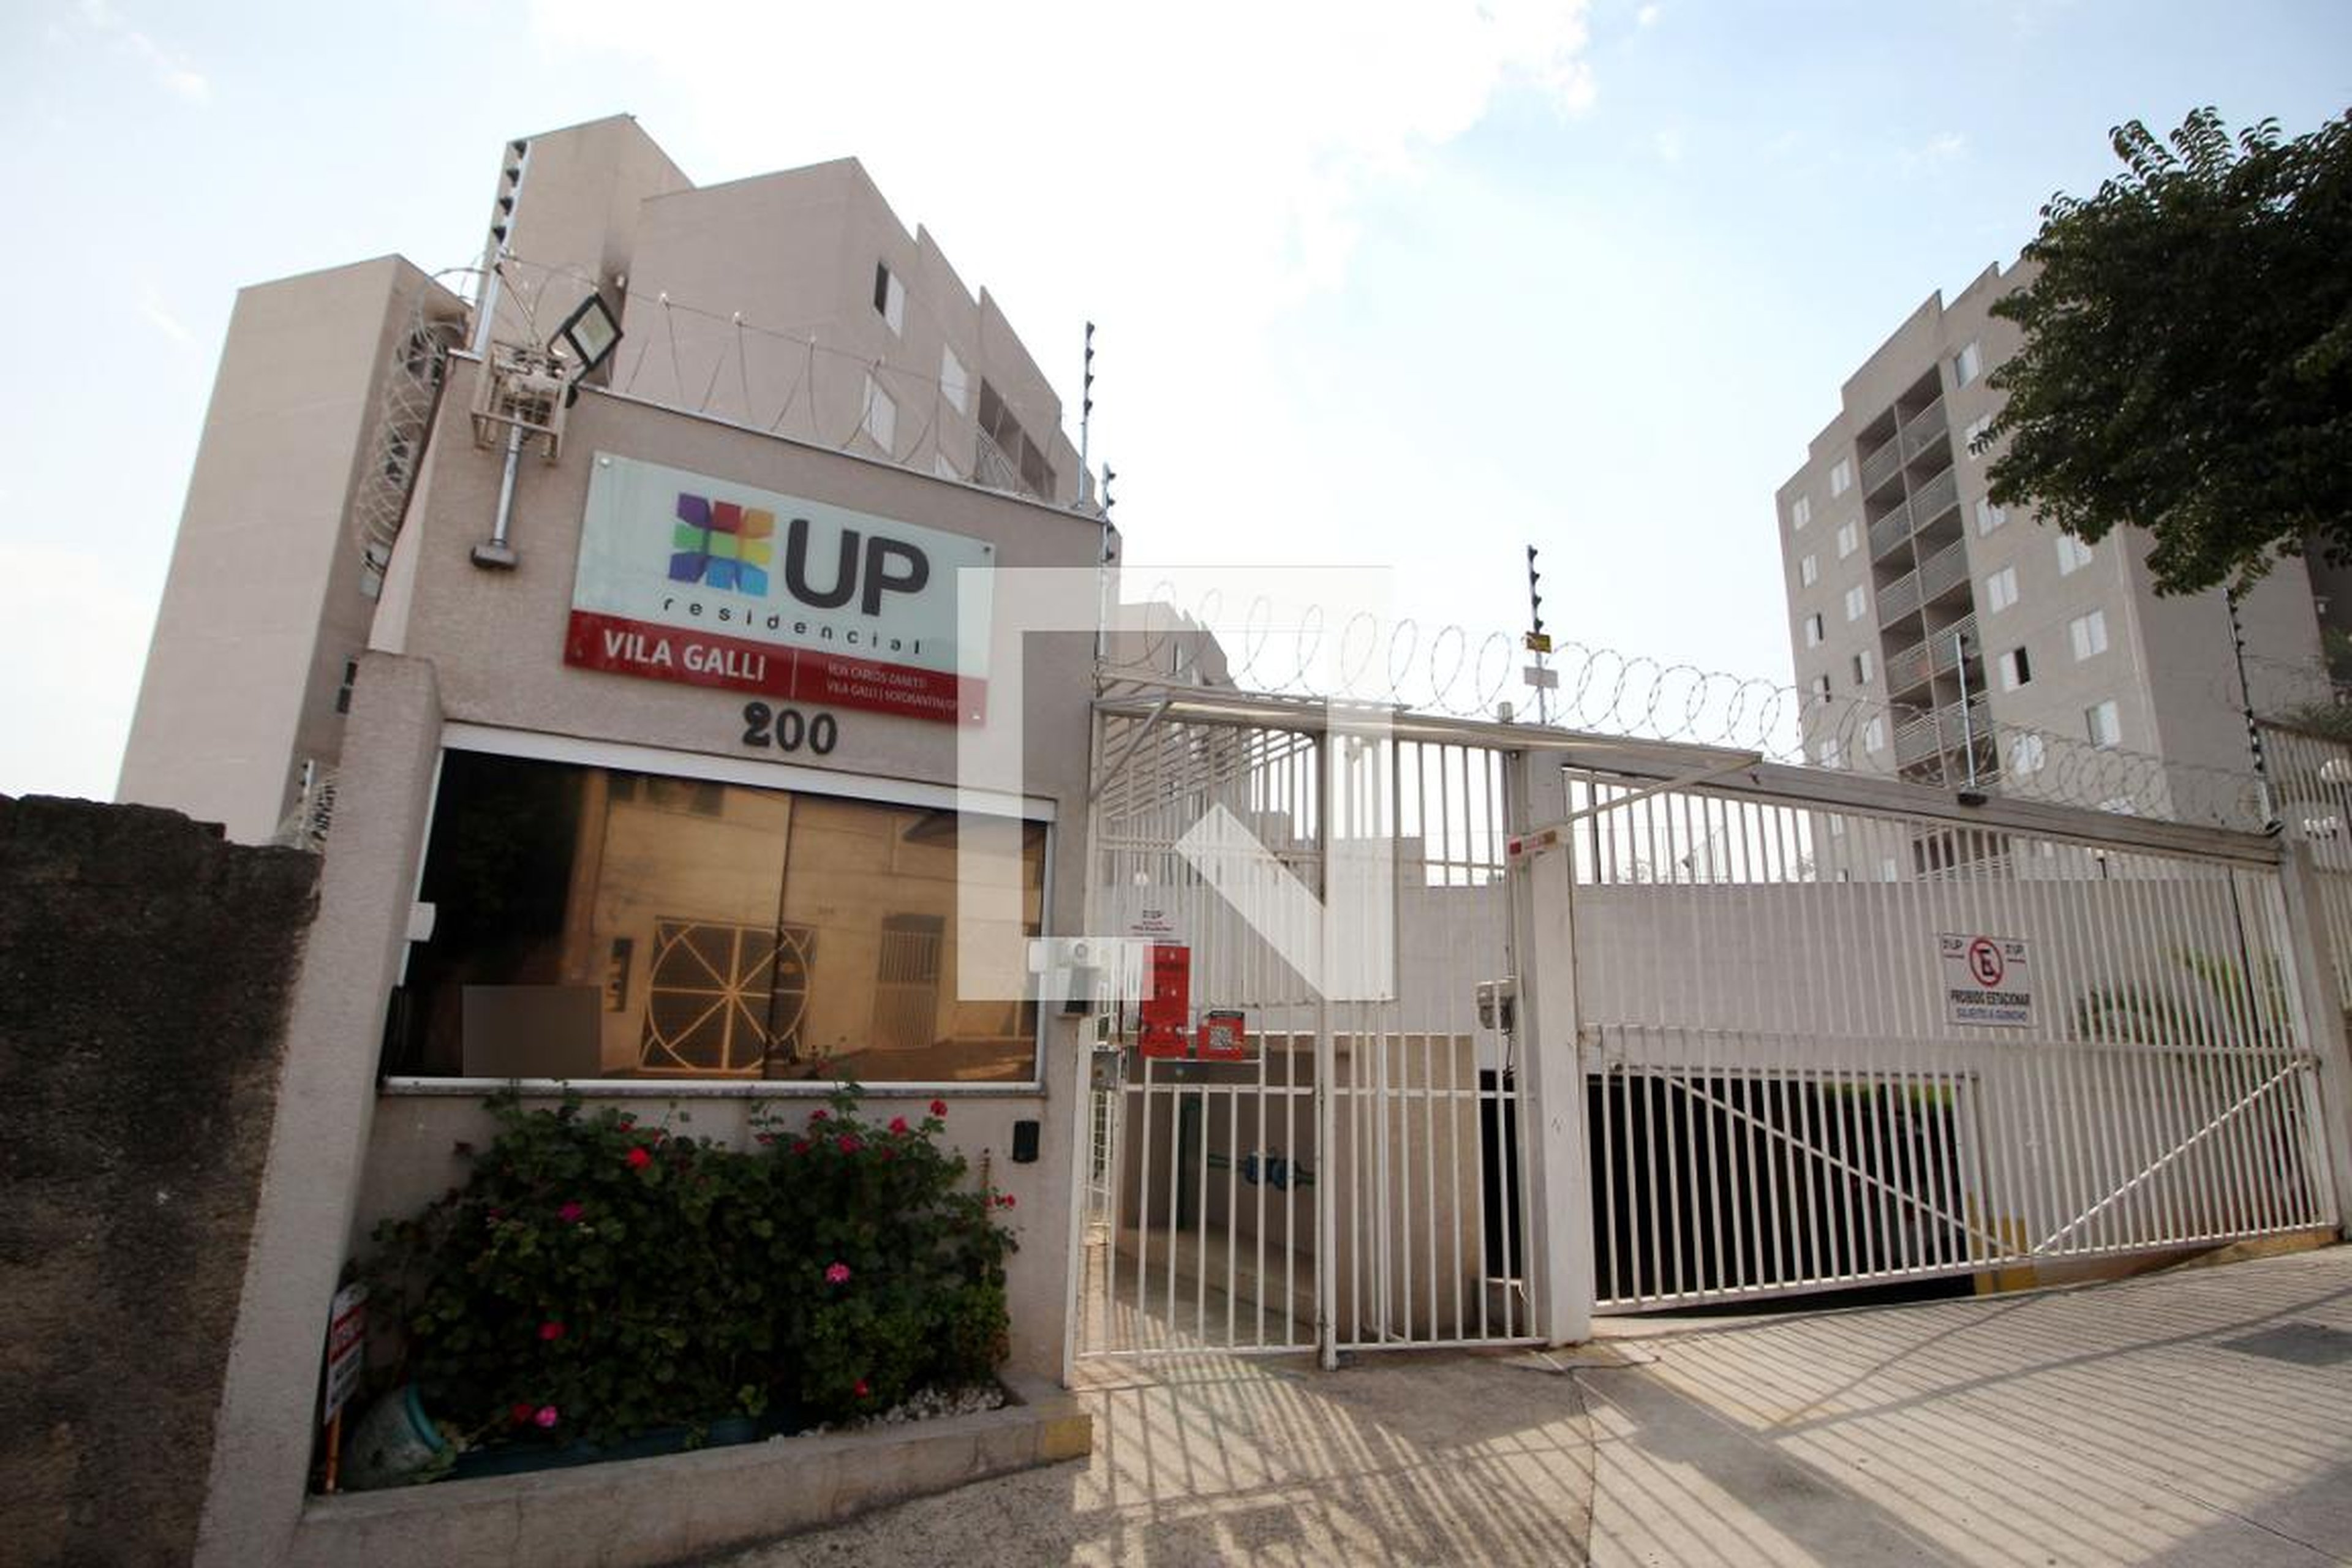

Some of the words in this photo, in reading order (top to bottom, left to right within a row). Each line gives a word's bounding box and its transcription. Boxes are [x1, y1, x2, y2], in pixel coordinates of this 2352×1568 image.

[785, 518, 929, 616] UP
[663, 595, 921, 655] residencial
[604, 629, 673, 666] VILA
[684, 644, 765, 681] GALLI
[742, 701, 838, 755] 200
